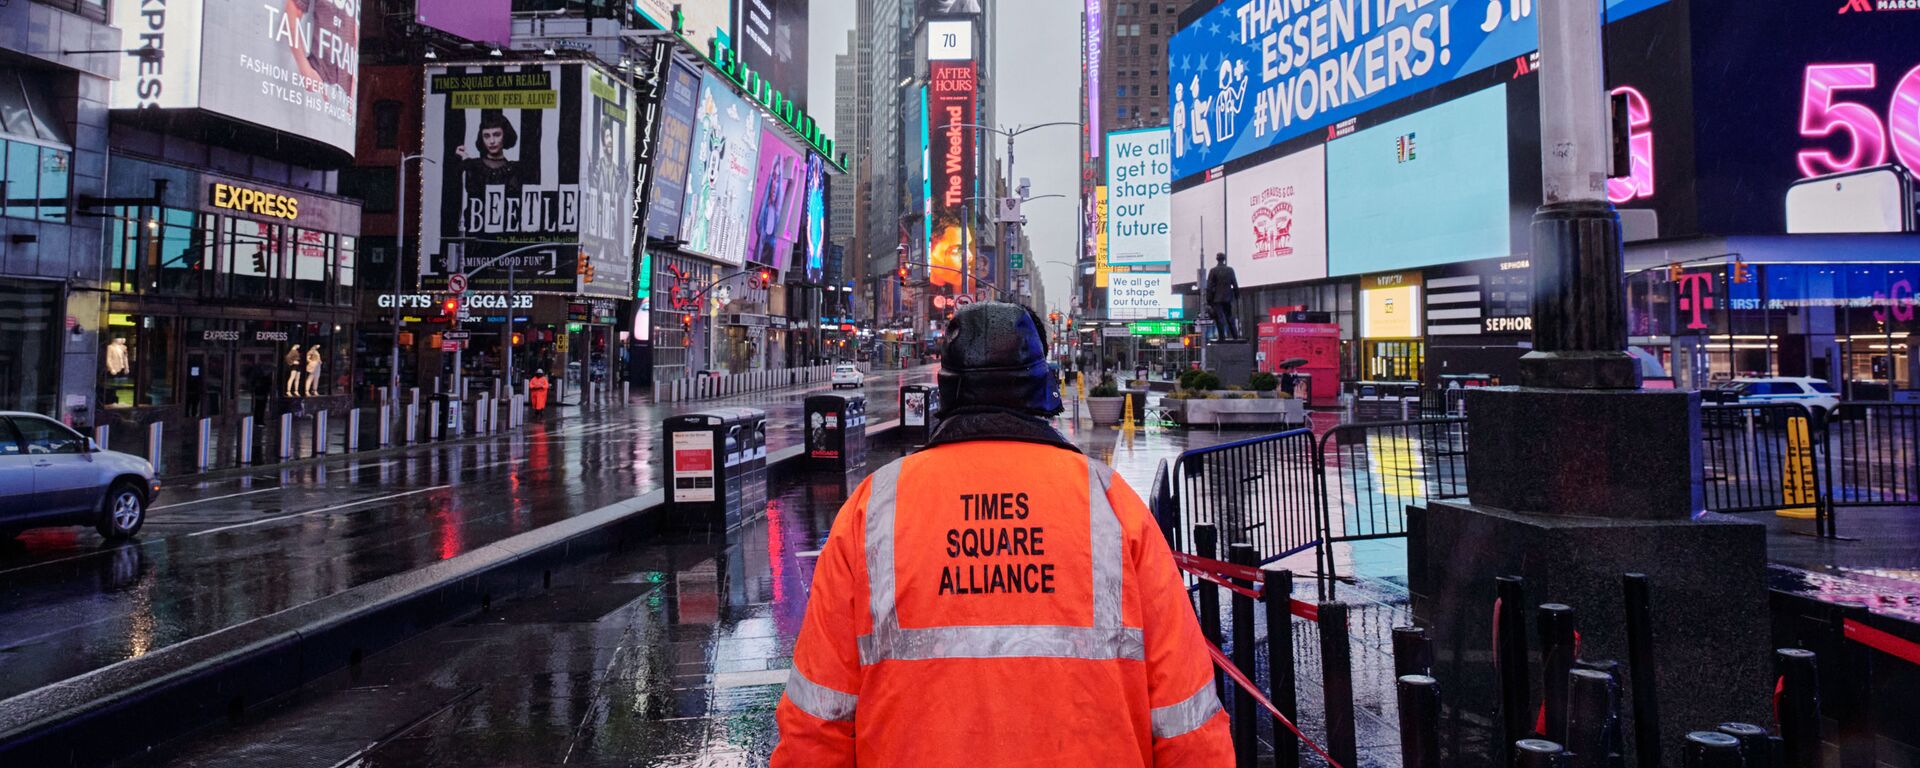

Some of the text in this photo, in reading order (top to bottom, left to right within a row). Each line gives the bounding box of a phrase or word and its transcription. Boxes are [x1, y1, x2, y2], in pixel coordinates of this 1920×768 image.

[264, 4, 312, 55] TAN
[333, 16, 342, 28] BY
[942, 33, 956, 48] 70
[240, 54, 288, 82] FASHION
[291, 72, 329, 97] EXPERT
[936, 67, 972, 80] AFTER
[1253, 5, 1451, 138] #WORKERS!
[434, 74, 547, 90] TIMES SQUARE CAN REALLY
[936, 80, 973, 92] HOURS
[261, 80, 302, 105] STYLES
[305, 97, 322, 112] HIS
[455, 92, 554, 107] MAKE YOU FEEL ALIVE!
[763, 79, 836, 160] BROADWAY
[946, 105, 962, 207] The Weeknd
[1116, 139, 1169, 158] We all
[1116, 160, 1168, 181] get to
[1116, 182, 1171, 199] shape
[215, 183, 298, 220] EXPRESS
[468, 187, 576, 232] BEETLE
[1116, 204, 1144, 217] our
[499, 256, 521, 266] GOOD
[1500, 260, 1529, 270] SEPHORA
[1113, 277, 1160, 287] We all get
[1113, 287, 1155, 297] to shape
[378, 294, 533, 308] GIFTS UGGAGE
[1130, 298, 1160, 306] future.
[1678, 272, 1714, 330] T
[1873, 279, 1914, 322] 5G
[1486, 317, 1532, 331] SEPHOR
[203, 331, 239, 340] EXPRESS
[256, 332, 288, 341] EXPRESS
[960, 492, 1030, 521] TIMES
[946, 527, 1045, 558] SQUARE
[938, 563, 1056, 596] ALLIANCE
